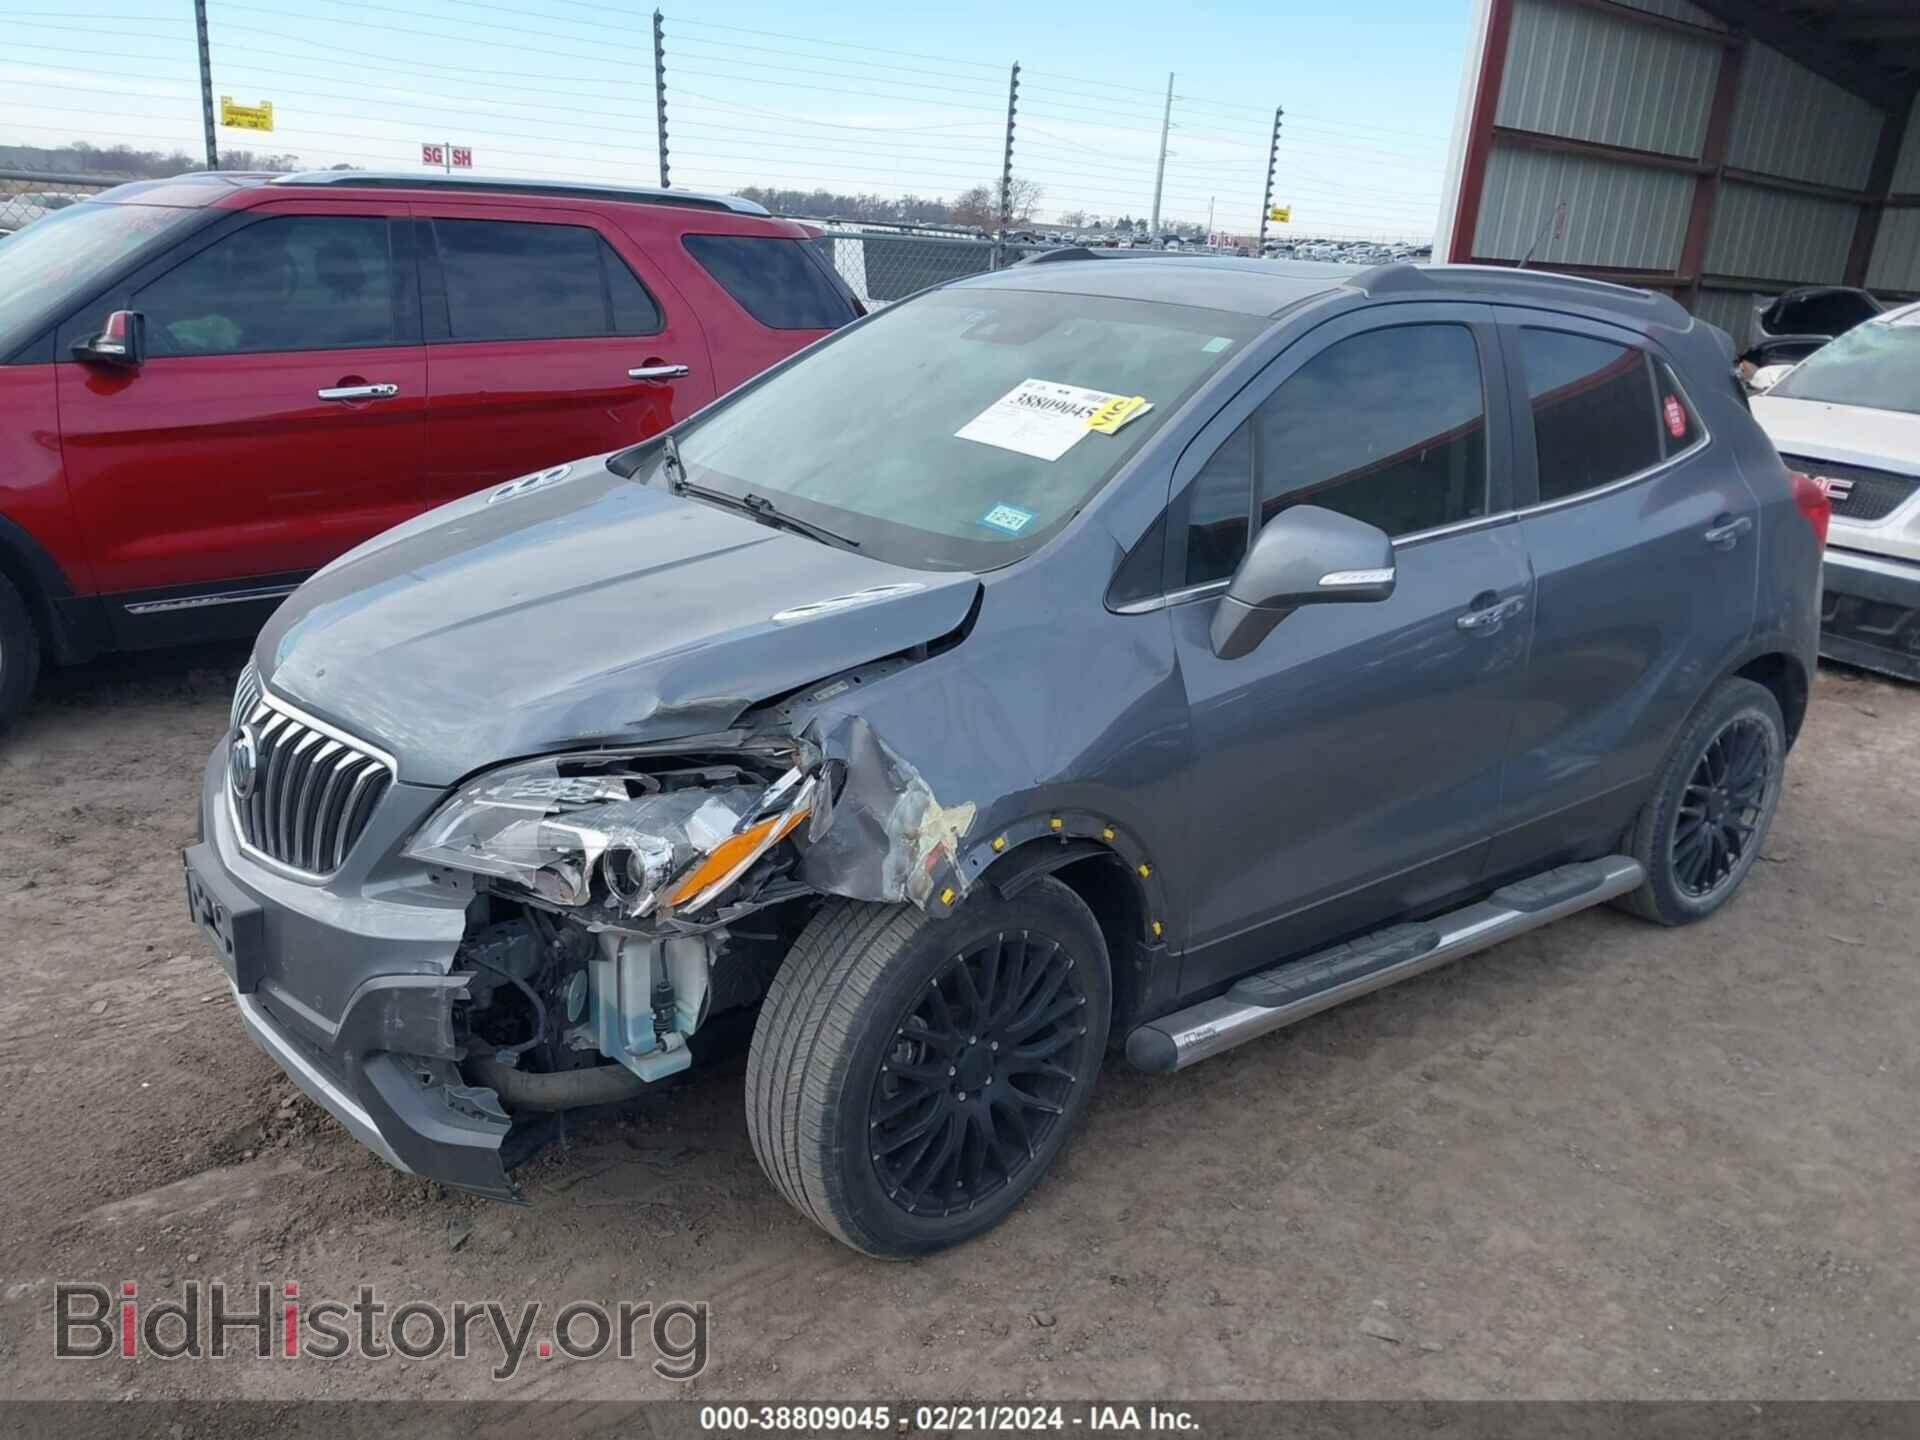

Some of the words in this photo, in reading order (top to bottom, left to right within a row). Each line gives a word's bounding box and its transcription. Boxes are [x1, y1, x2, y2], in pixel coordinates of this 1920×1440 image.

[423, 146, 443, 164] SG
[452, 149, 471, 166] SH
[1009, 393, 1099, 419] 38809045
